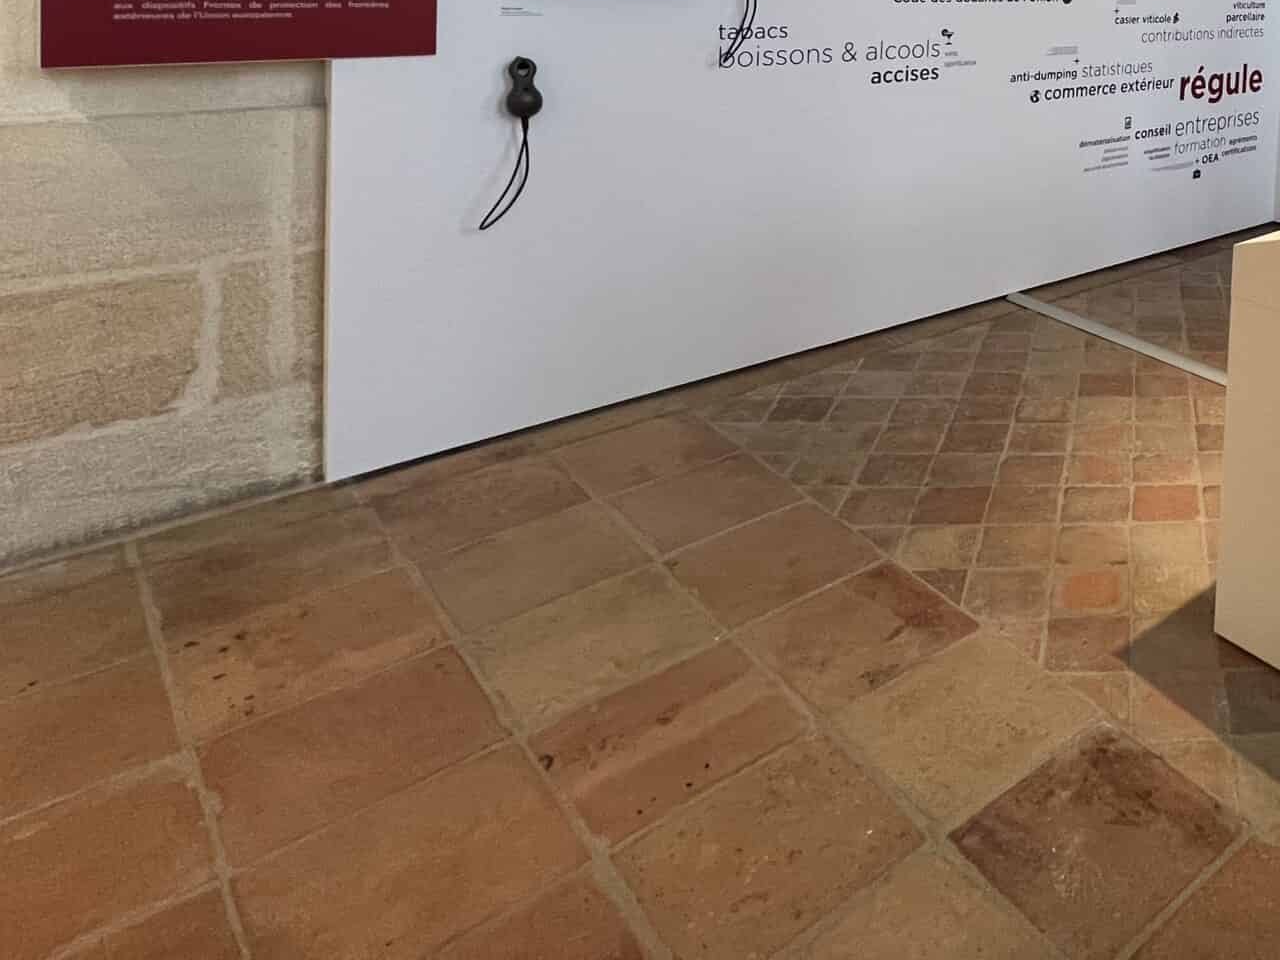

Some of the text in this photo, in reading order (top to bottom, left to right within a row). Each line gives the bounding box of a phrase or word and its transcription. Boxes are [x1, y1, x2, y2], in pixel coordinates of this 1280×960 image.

[1114, 13, 1172, 25] casier viticole
[1226, 12, 1265, 24] parcellaire
[719, 24, 788, 40] tabacs
[1142, 25, 1264, 44] contributions indirectes
[719, 39, 940, 68] boissons & alcools
[870, 66, 940, 84] accises
[1010, 61, 1153, 83] anti-dumping statistiques
[1044, 76, 1175, 101] commerce extérieur
[1179, 63, 1263, 104] régule
[1134, 110, 1260, 140] conseil entreprises
[1174, 134, 1226, 155] formation
[1202, 153, 1219, 164] OEA
